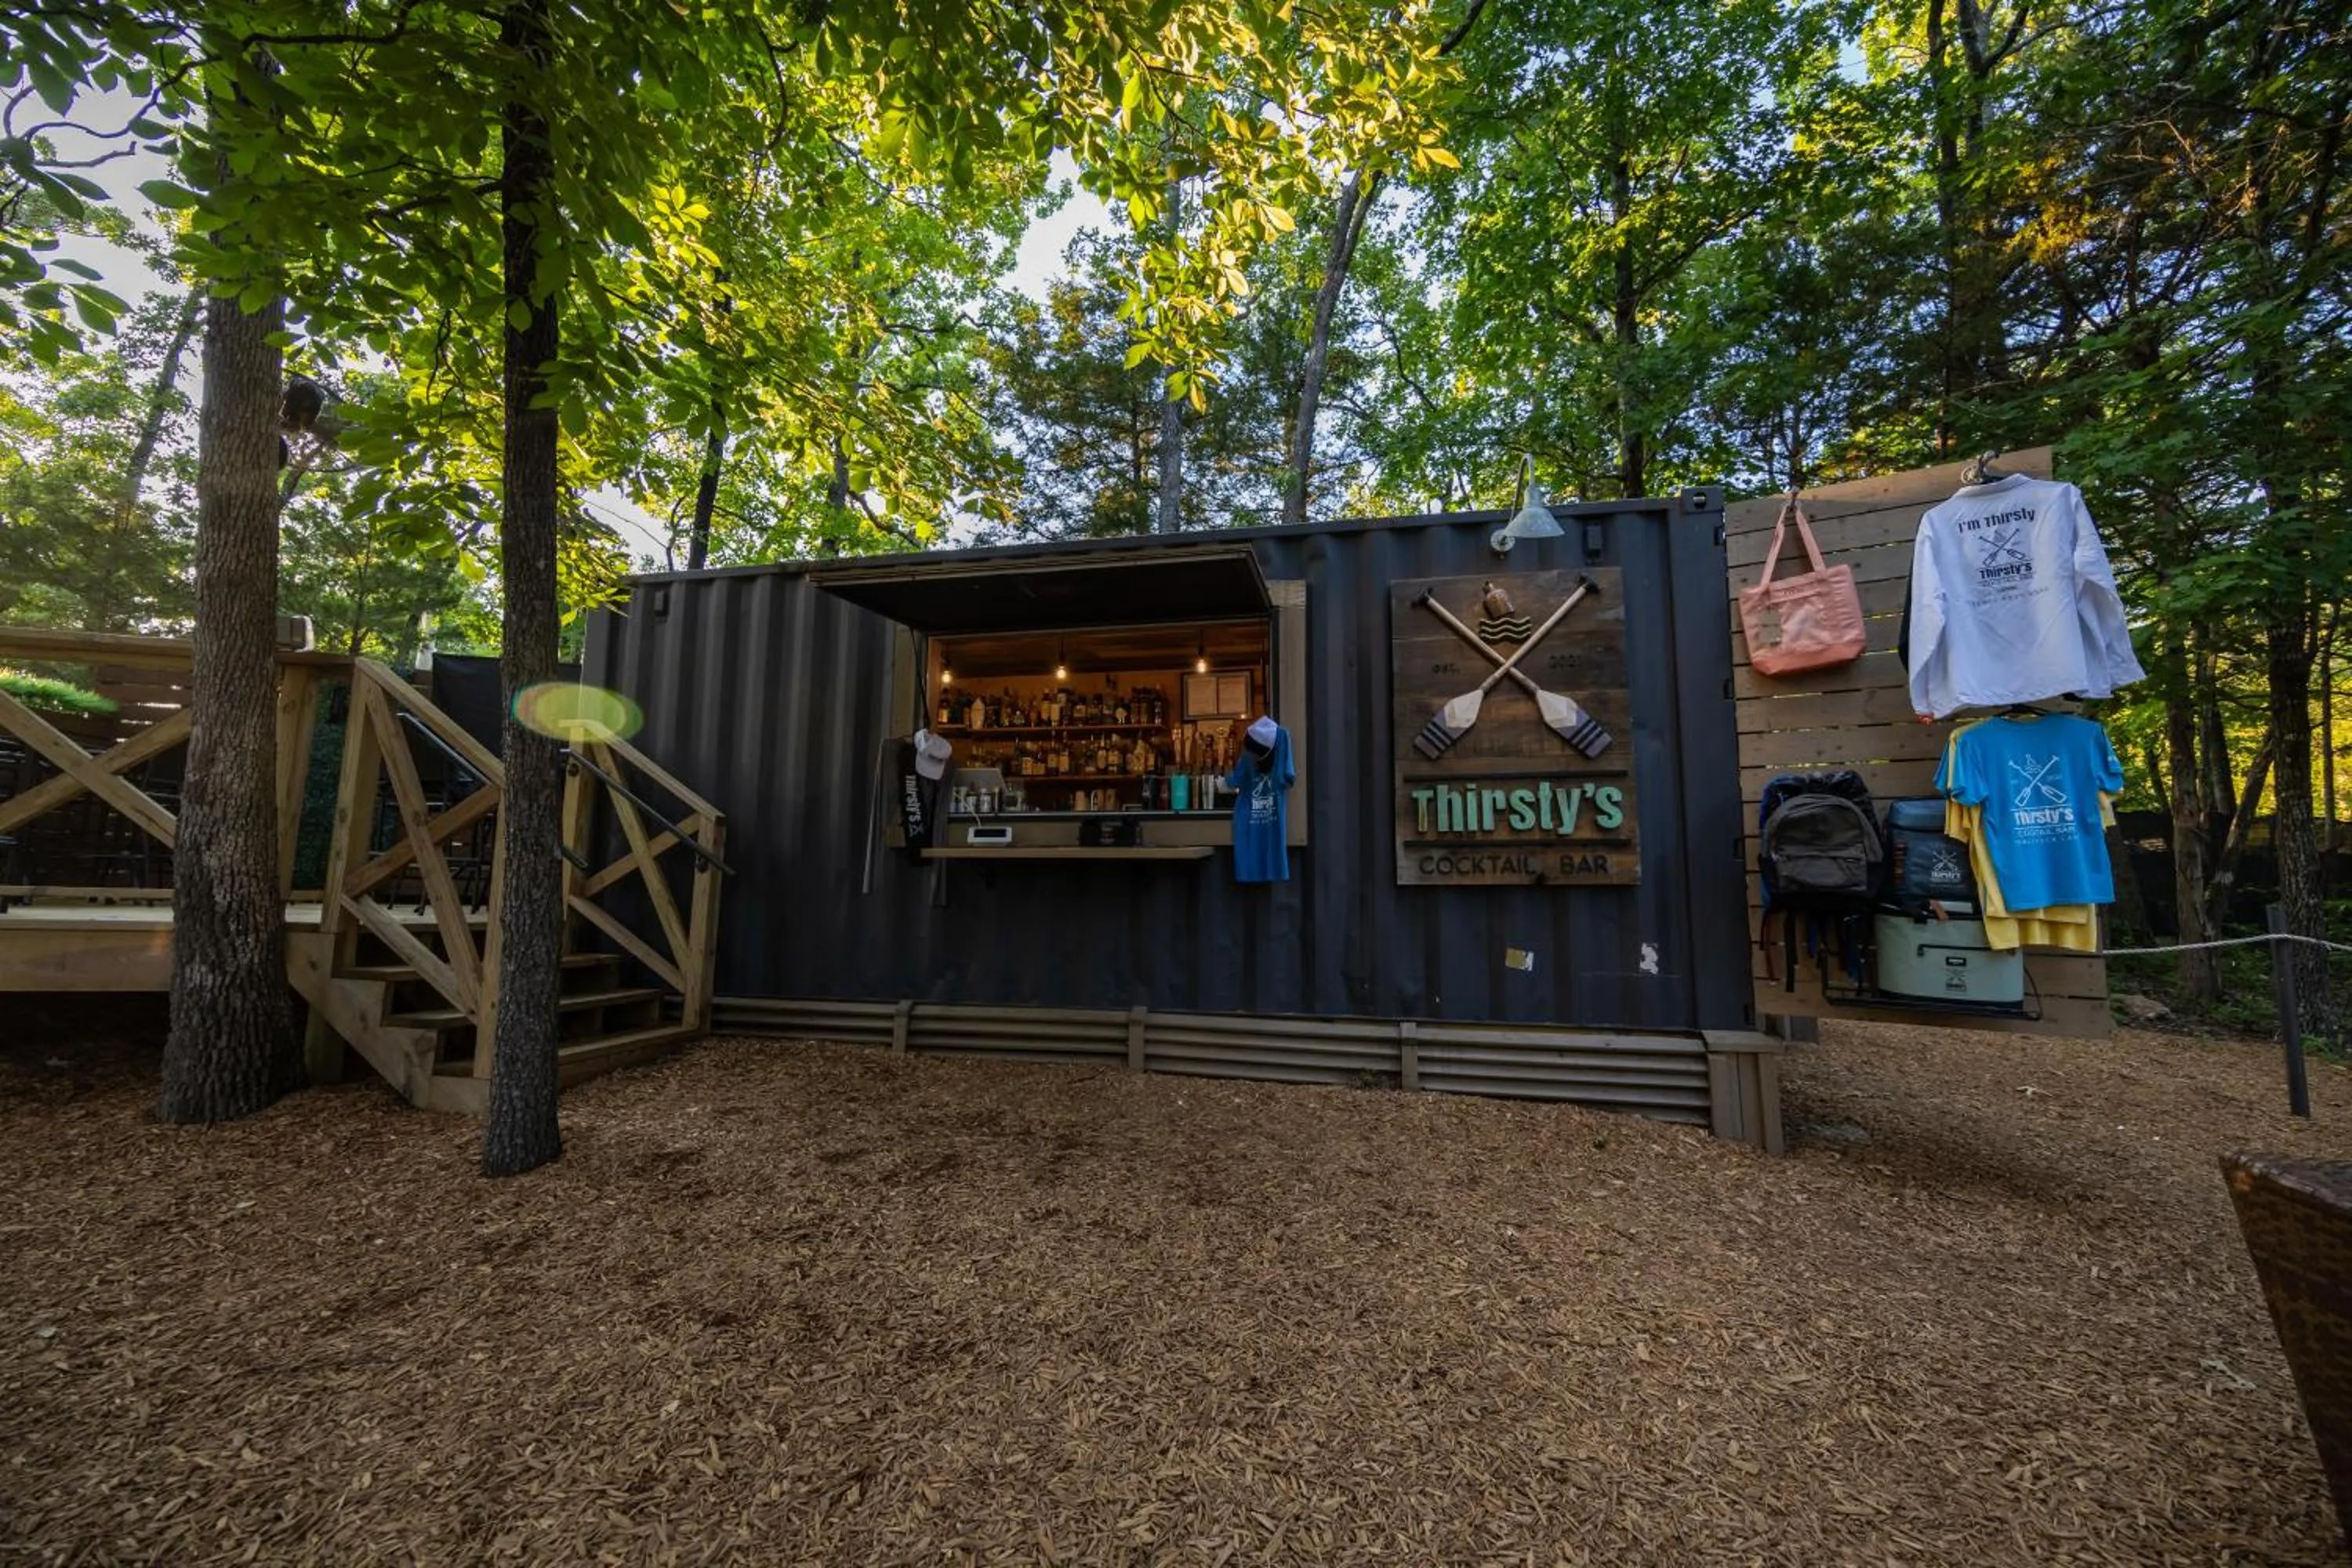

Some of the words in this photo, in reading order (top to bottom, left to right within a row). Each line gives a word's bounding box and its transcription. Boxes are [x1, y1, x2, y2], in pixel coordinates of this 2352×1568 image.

[1958, 519, 1981, 534] I'm
[1984, 507, 2035, 528] Thirsty
[1980, 562, 2032, 579] Thirsty's
[1412, 782, 1624, 835] Thirsty's
[2013, 808, 2074, 826] Thirsty's
[1419, 855, 1537, 877] COCKTAIL
[1559, 855, 1610, 875] BAR
